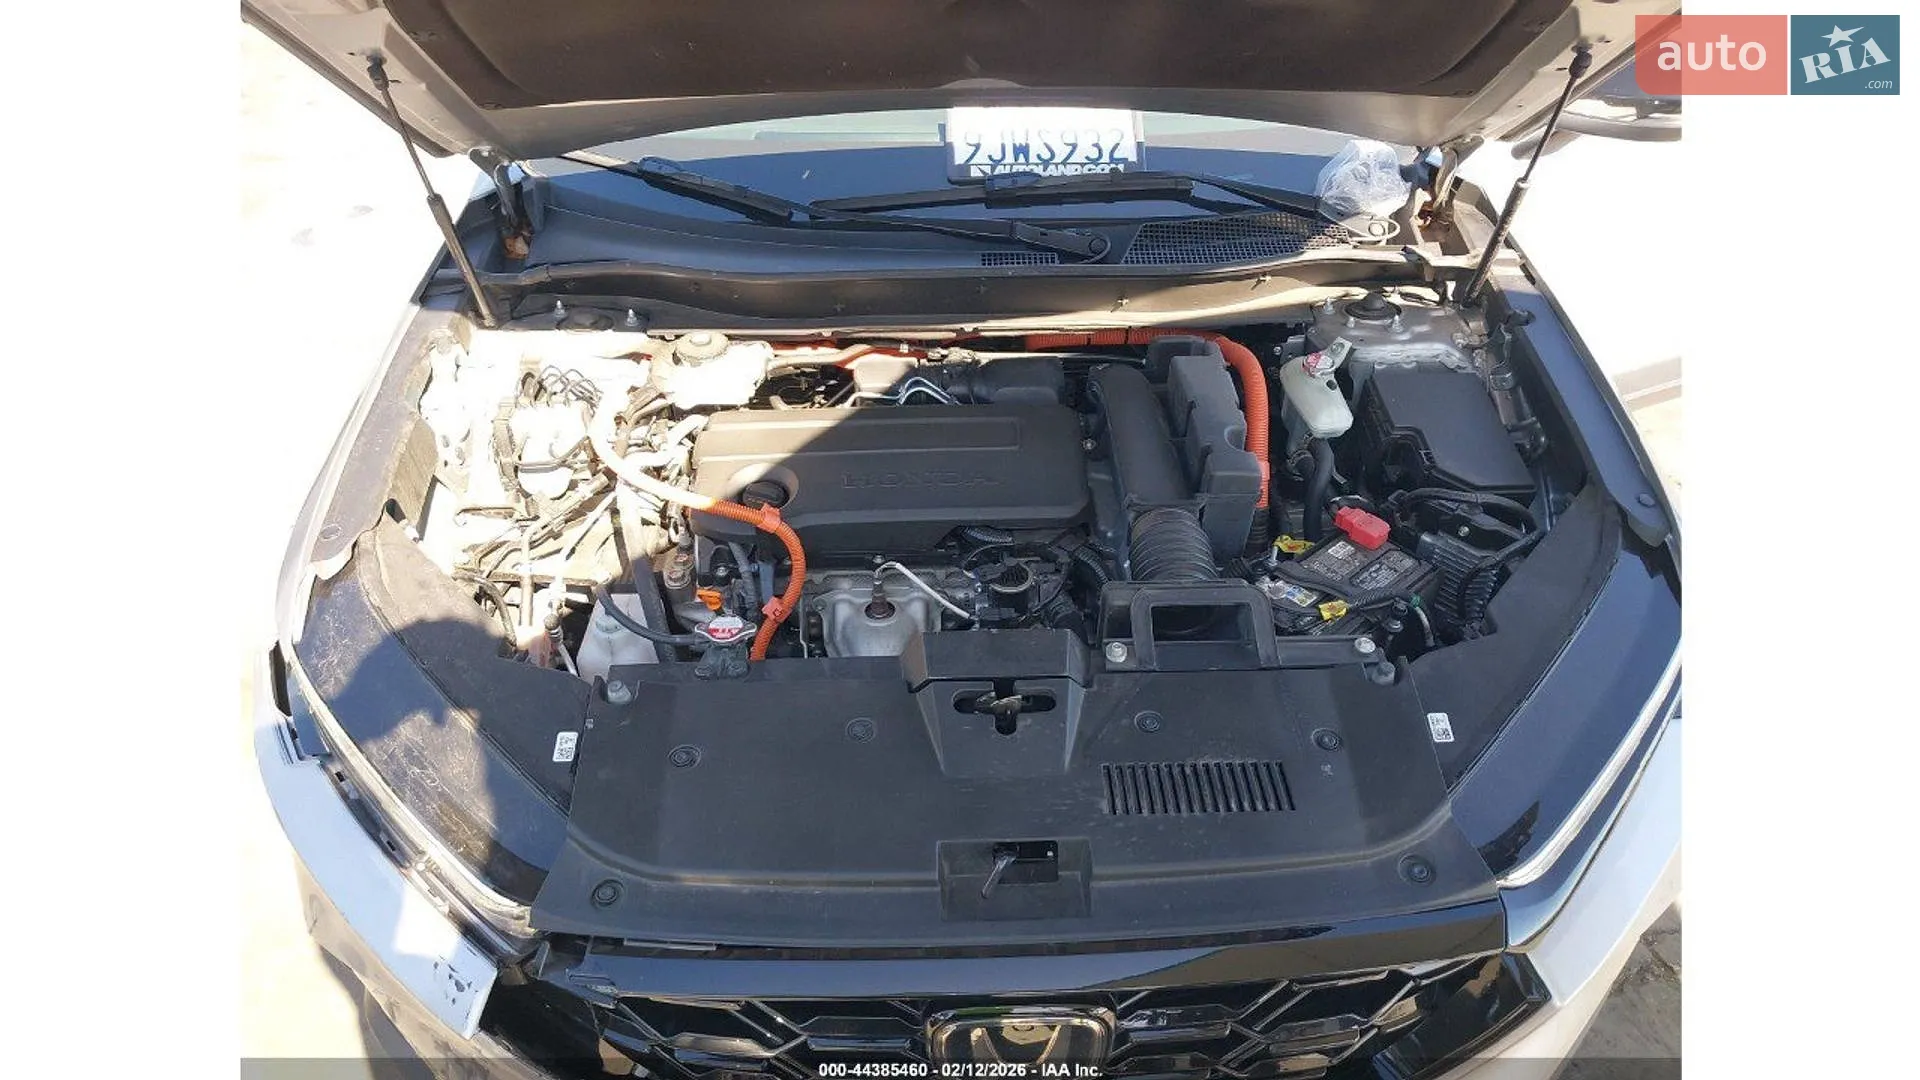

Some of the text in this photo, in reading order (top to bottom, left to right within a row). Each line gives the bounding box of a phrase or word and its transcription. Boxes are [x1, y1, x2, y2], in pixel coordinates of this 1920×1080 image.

[964, 129, 1128, 164] 9JWS932
[993, 164, 1125, 177] AUTOLANDCOM
[841, 470, 999, 490] HONDA
